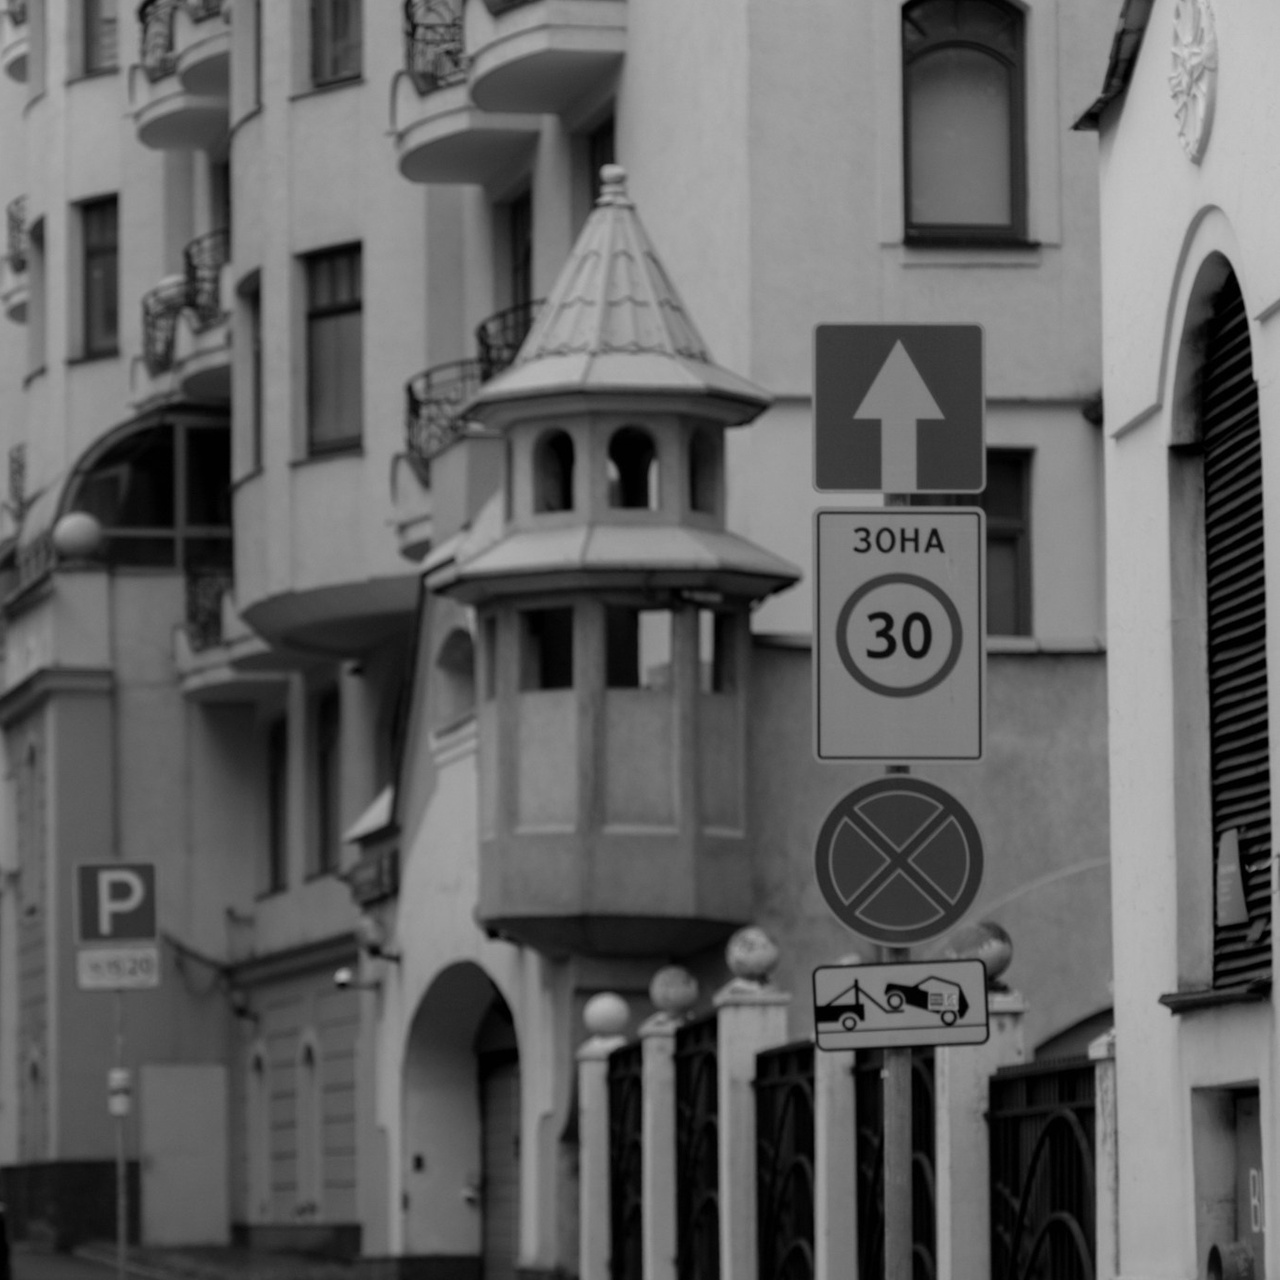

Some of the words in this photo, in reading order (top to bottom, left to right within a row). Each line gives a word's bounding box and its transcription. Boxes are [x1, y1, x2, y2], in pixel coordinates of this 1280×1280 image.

[853, 527, 945, 553] ЗОНА
[866, 611, 932, 660] 30
[98, 869, 145, 936] P
